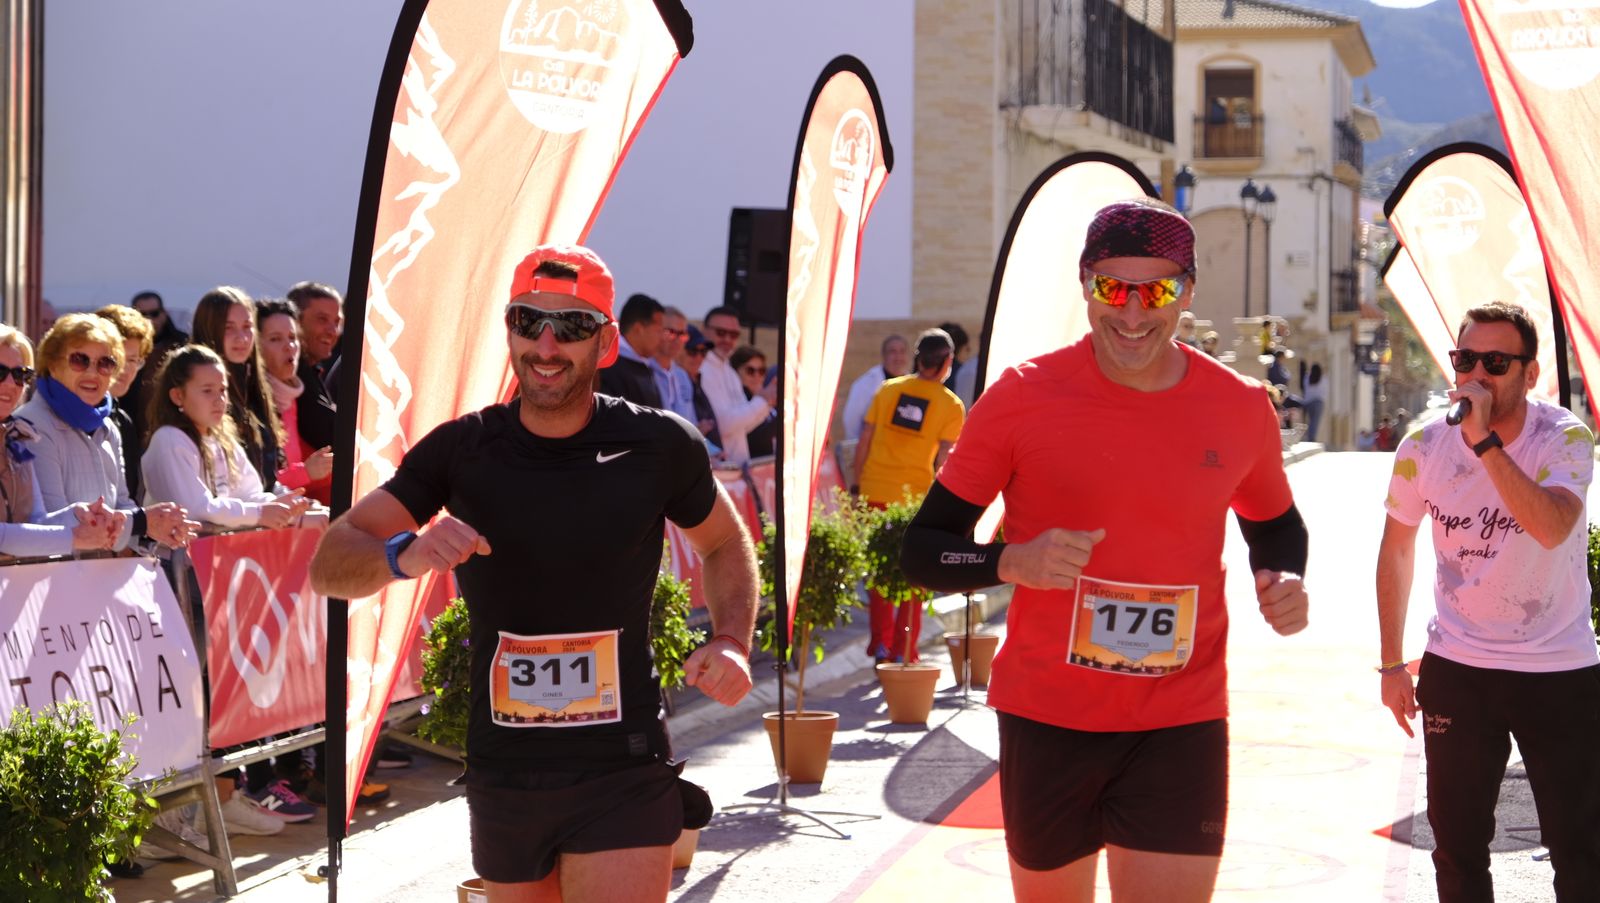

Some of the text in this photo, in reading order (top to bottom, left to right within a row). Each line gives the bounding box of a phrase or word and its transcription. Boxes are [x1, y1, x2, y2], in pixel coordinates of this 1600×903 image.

[512, 68, 533, 88] LA
[127, 612, 163, 642] DE
[1097, 603, 1175, 636] 176
[562, 640, 591, 648] CANTORIA
[511, 656, 590, 687] 311
[9, 654, 182, 728] TORIA
